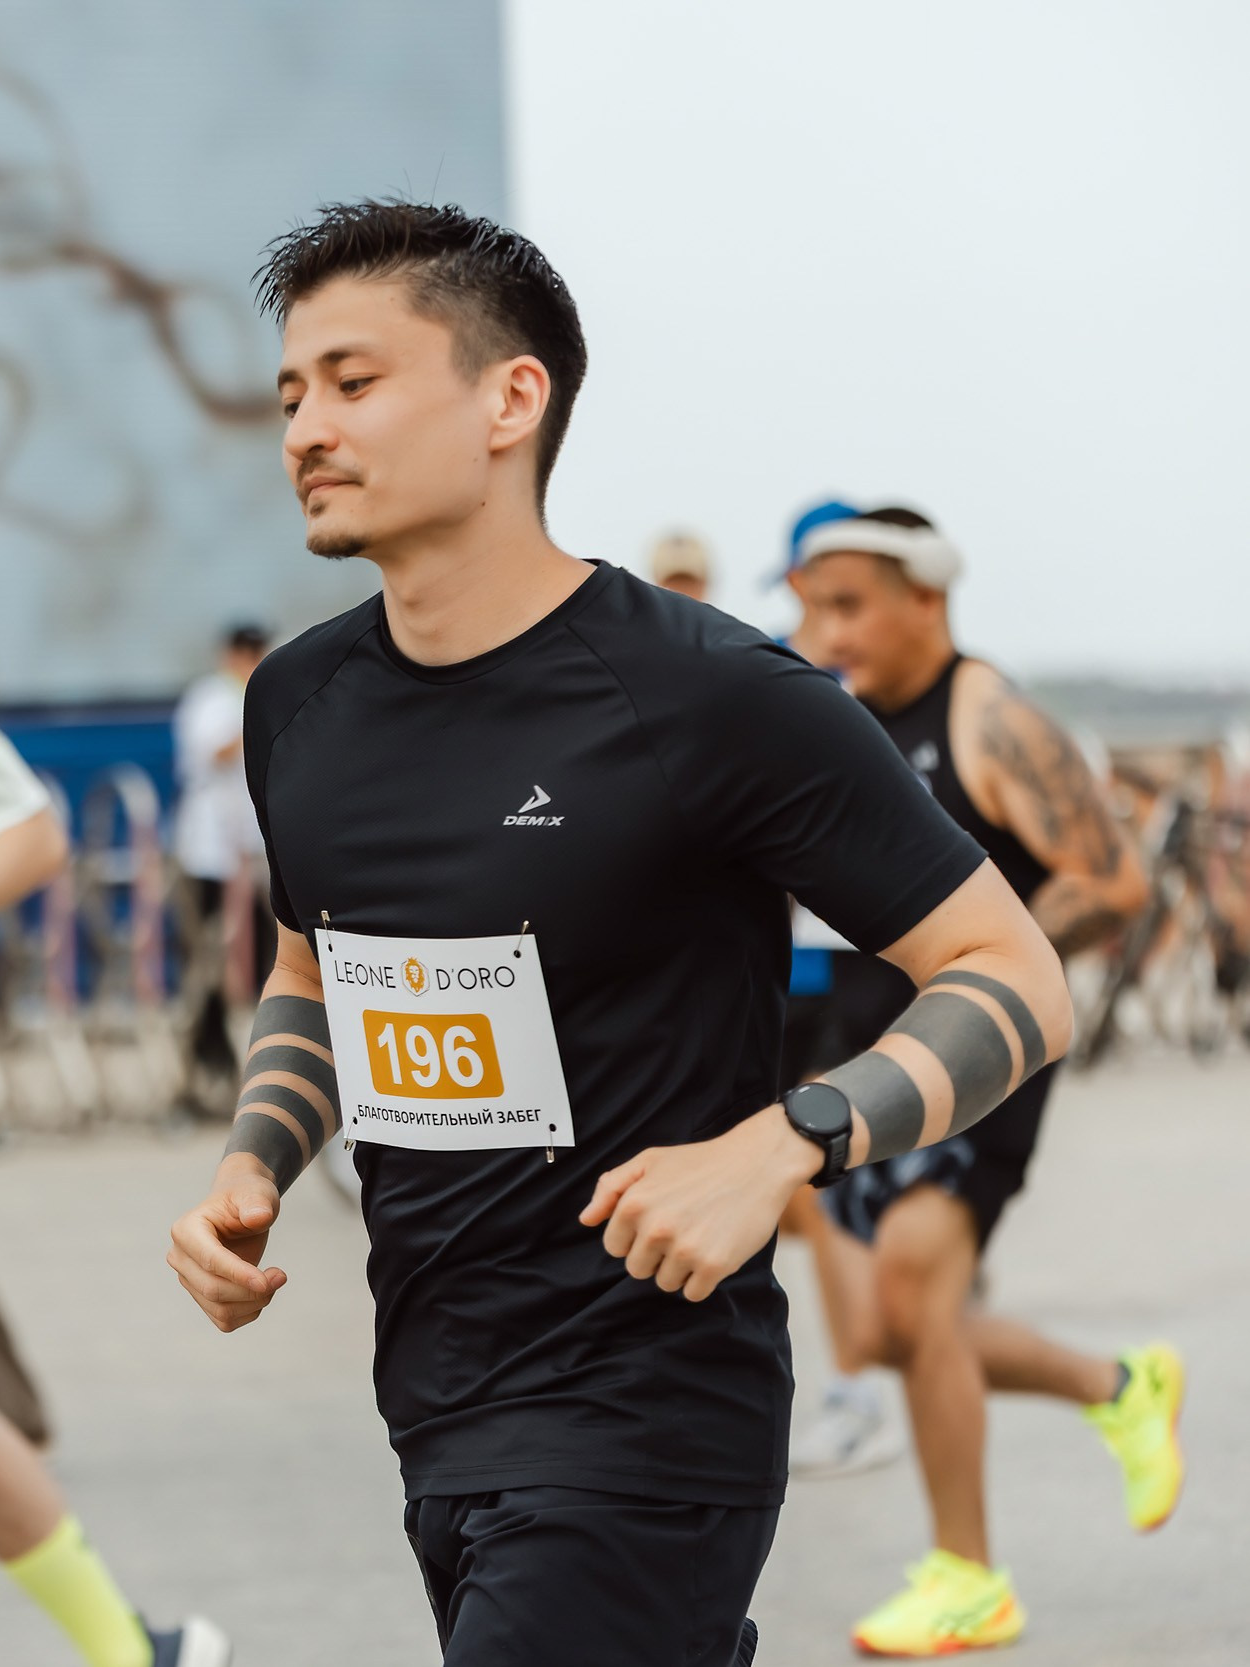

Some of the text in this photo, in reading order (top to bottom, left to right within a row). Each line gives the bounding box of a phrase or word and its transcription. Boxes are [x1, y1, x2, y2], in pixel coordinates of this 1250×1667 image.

[503, 815, 565, 826] DEMIX
[334, 960, 515, 991] LEONE D'ORO
[377, 1022, 484, 1088] 196
[357, 1104, 541, 1126] БЛАГОТВОРИТЕЛЬНЫЙ ЗАБЕГ
